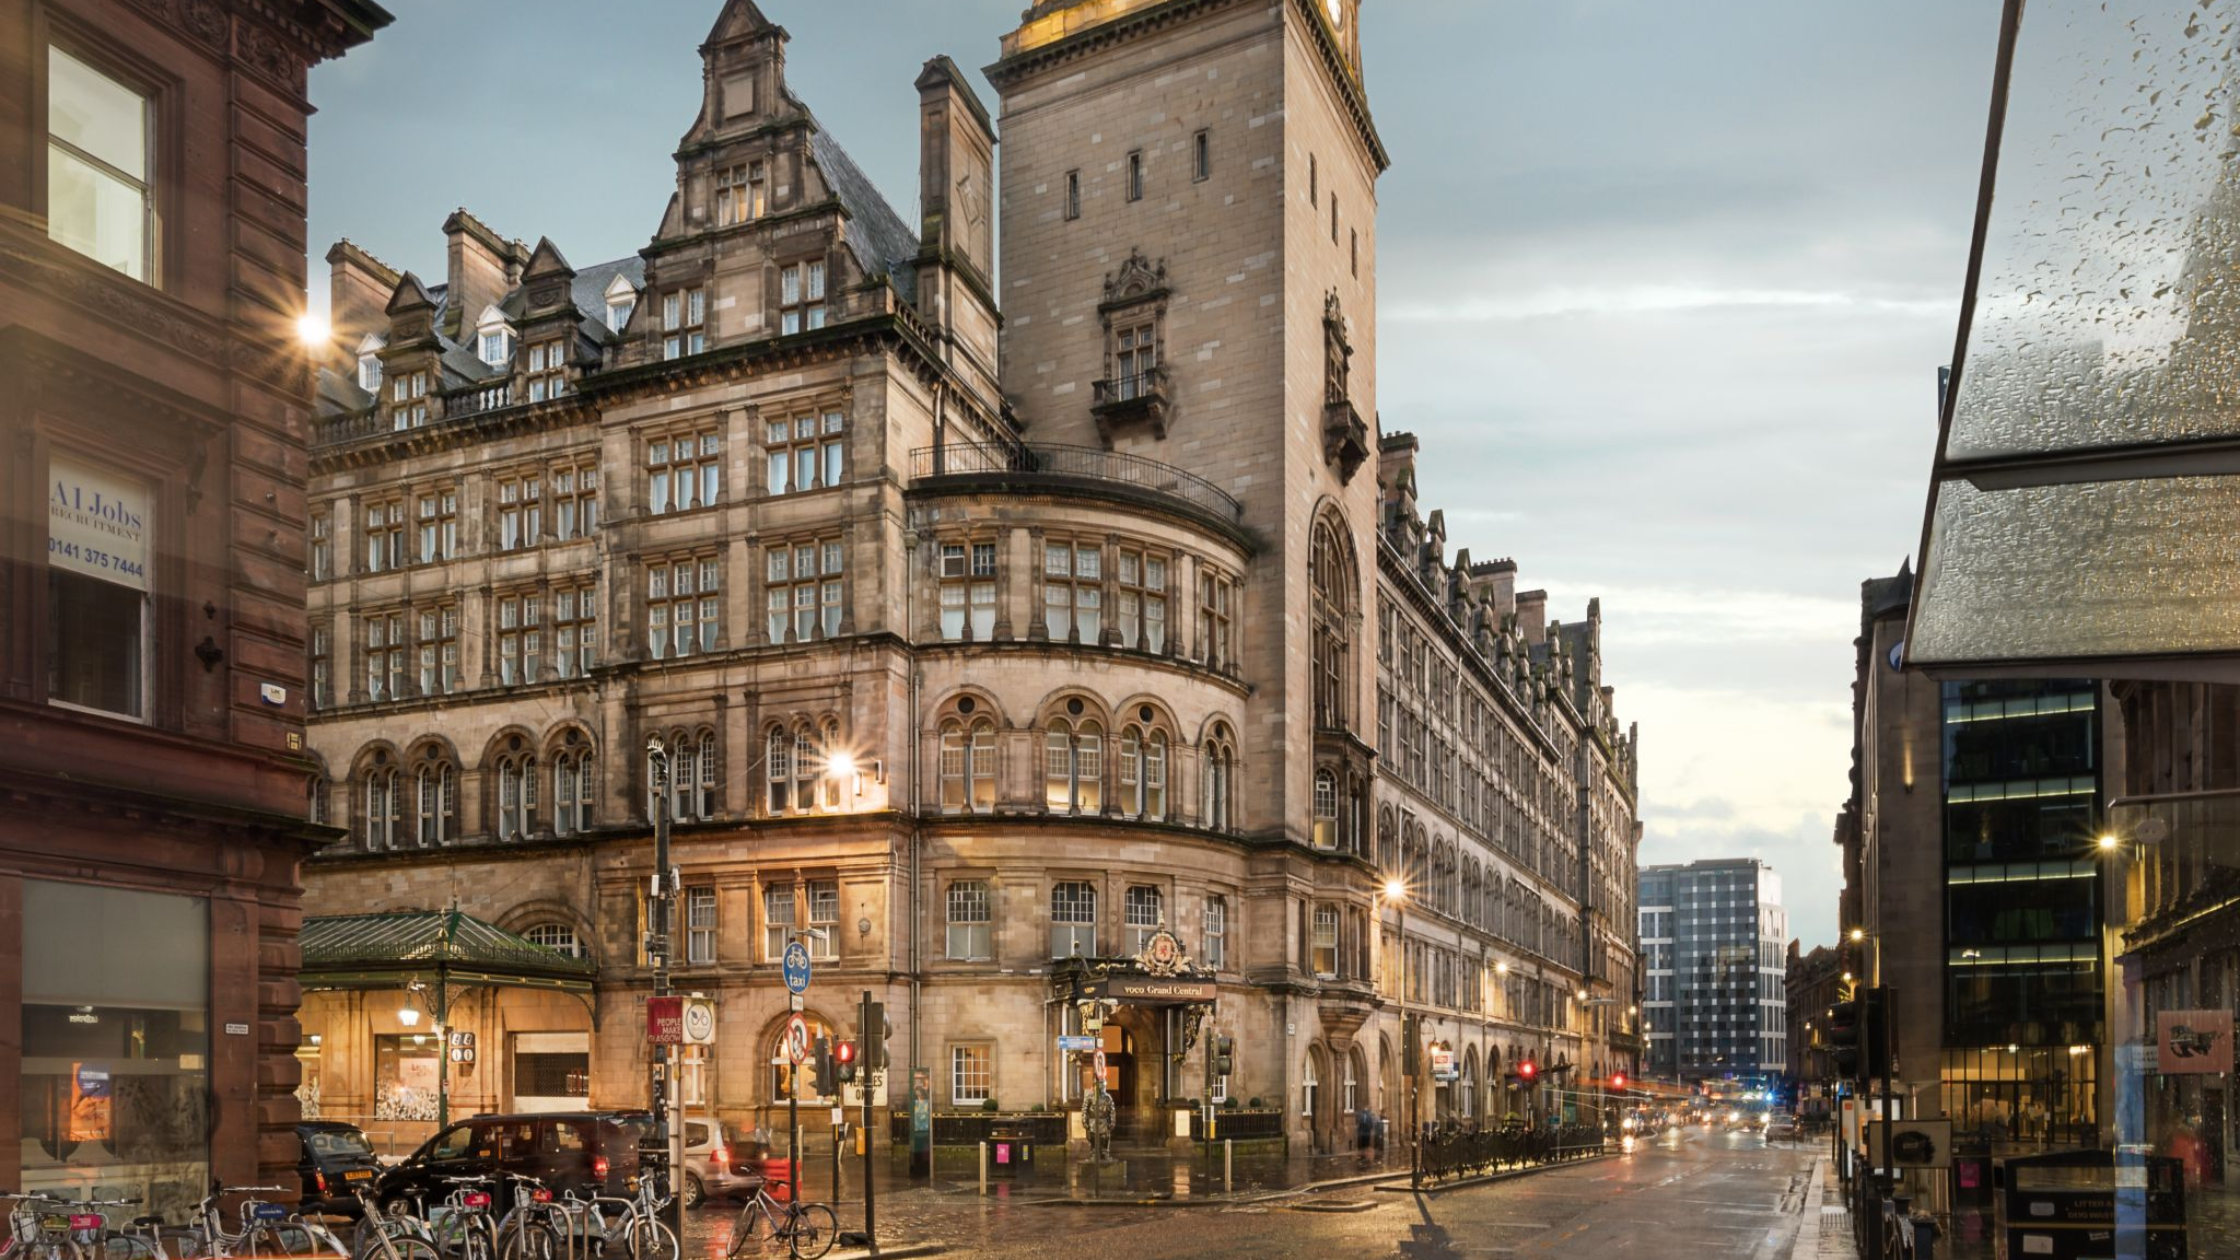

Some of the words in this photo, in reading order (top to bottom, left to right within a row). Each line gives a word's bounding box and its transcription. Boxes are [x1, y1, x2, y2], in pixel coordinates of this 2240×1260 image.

[51, 481, 81, 510] A1
[89, 493, 142, 529] Jobs
[51, 506, 140, 541] RECRUITMENT
[49, 537, 79, 559] 0141
[84, 548, 108, 568] 375
[112, 556, 143, 577] 7444
[789, 973, 806, 987] taxi
[1125, 985, 1145, 993] voco
[1146, 985, 1172, 995] Grand
[1174, 985, 1202, 996] Central
[657, 1017, 682, 1027] PEOPLE
[662, 1027, 682, 1035] MAKE
[648, 1034, 682, 1042] GLASGOW
